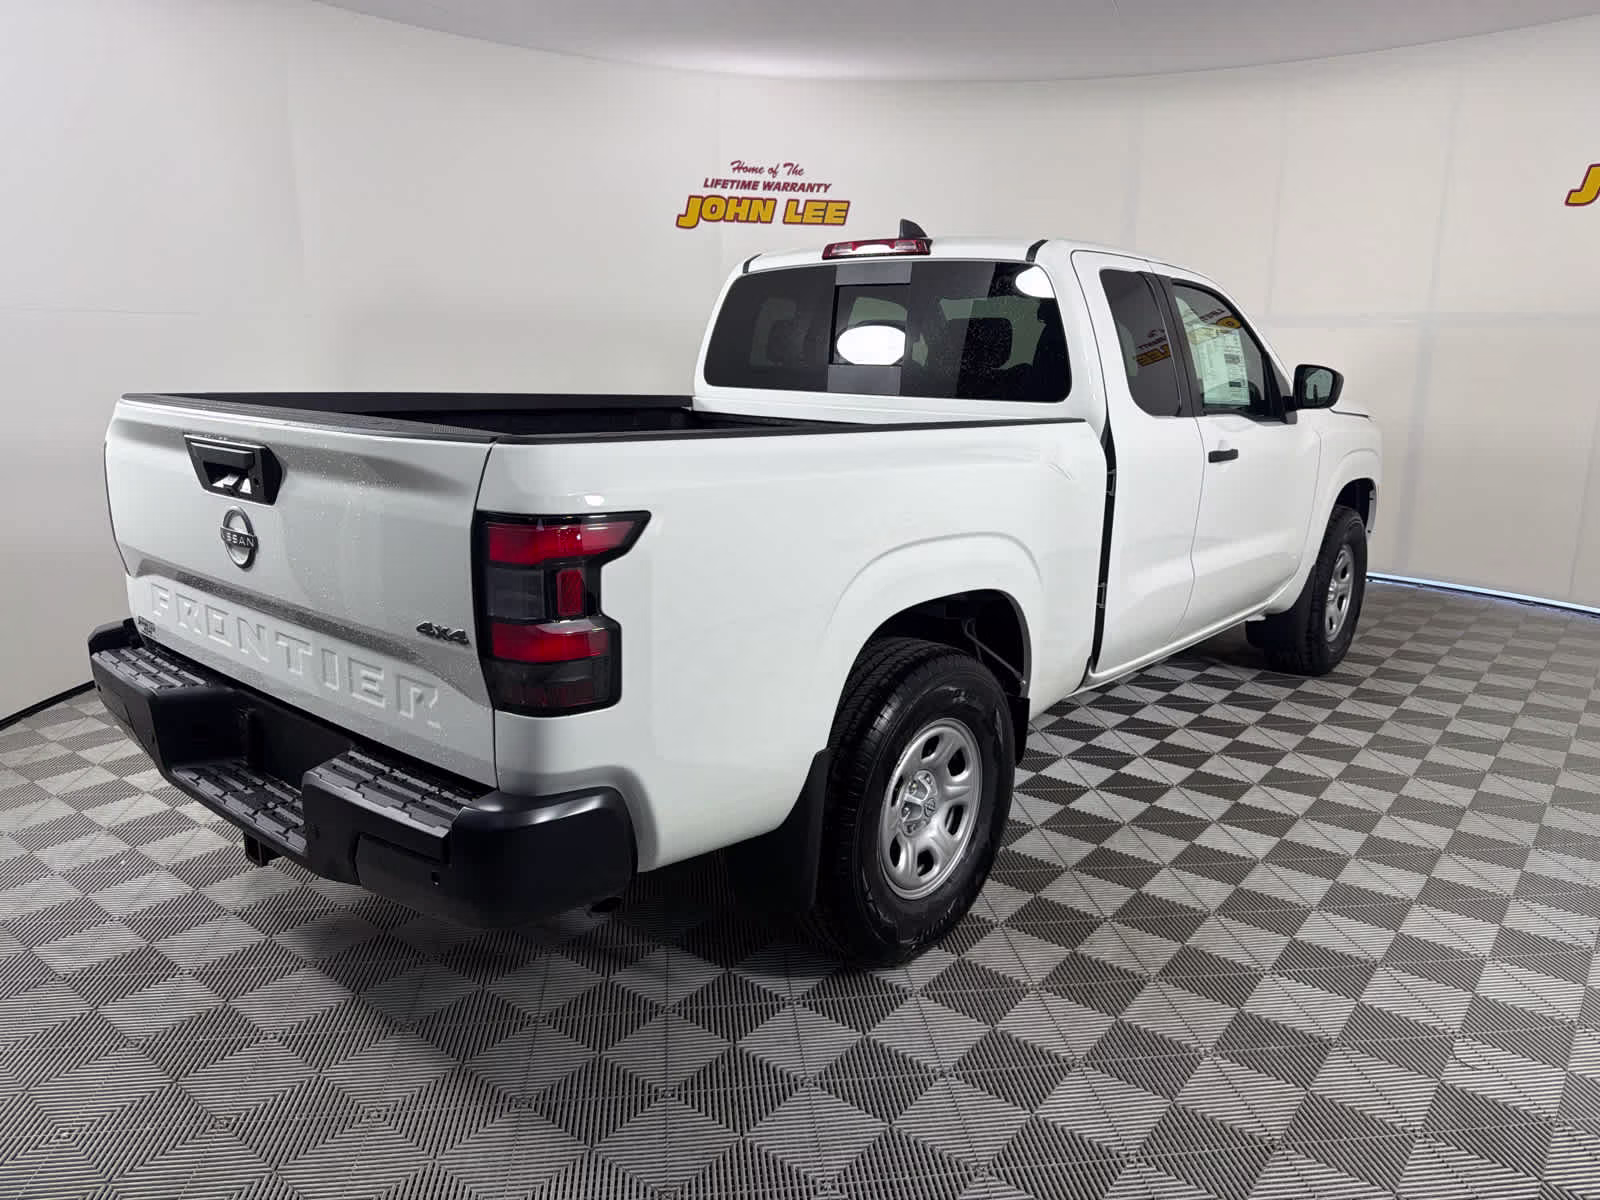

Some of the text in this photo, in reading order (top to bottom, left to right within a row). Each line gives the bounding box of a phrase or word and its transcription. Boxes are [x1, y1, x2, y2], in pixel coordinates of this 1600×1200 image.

[730, 159, 805, 178] Home of The
[703, 178, 832, 193] LIFETIME WARRANTY
[676, 195, 851, 229] JOHN LEE
[222, 531, 254, 548] SSAN
[151, 583, 441, 729] FRONTIER
